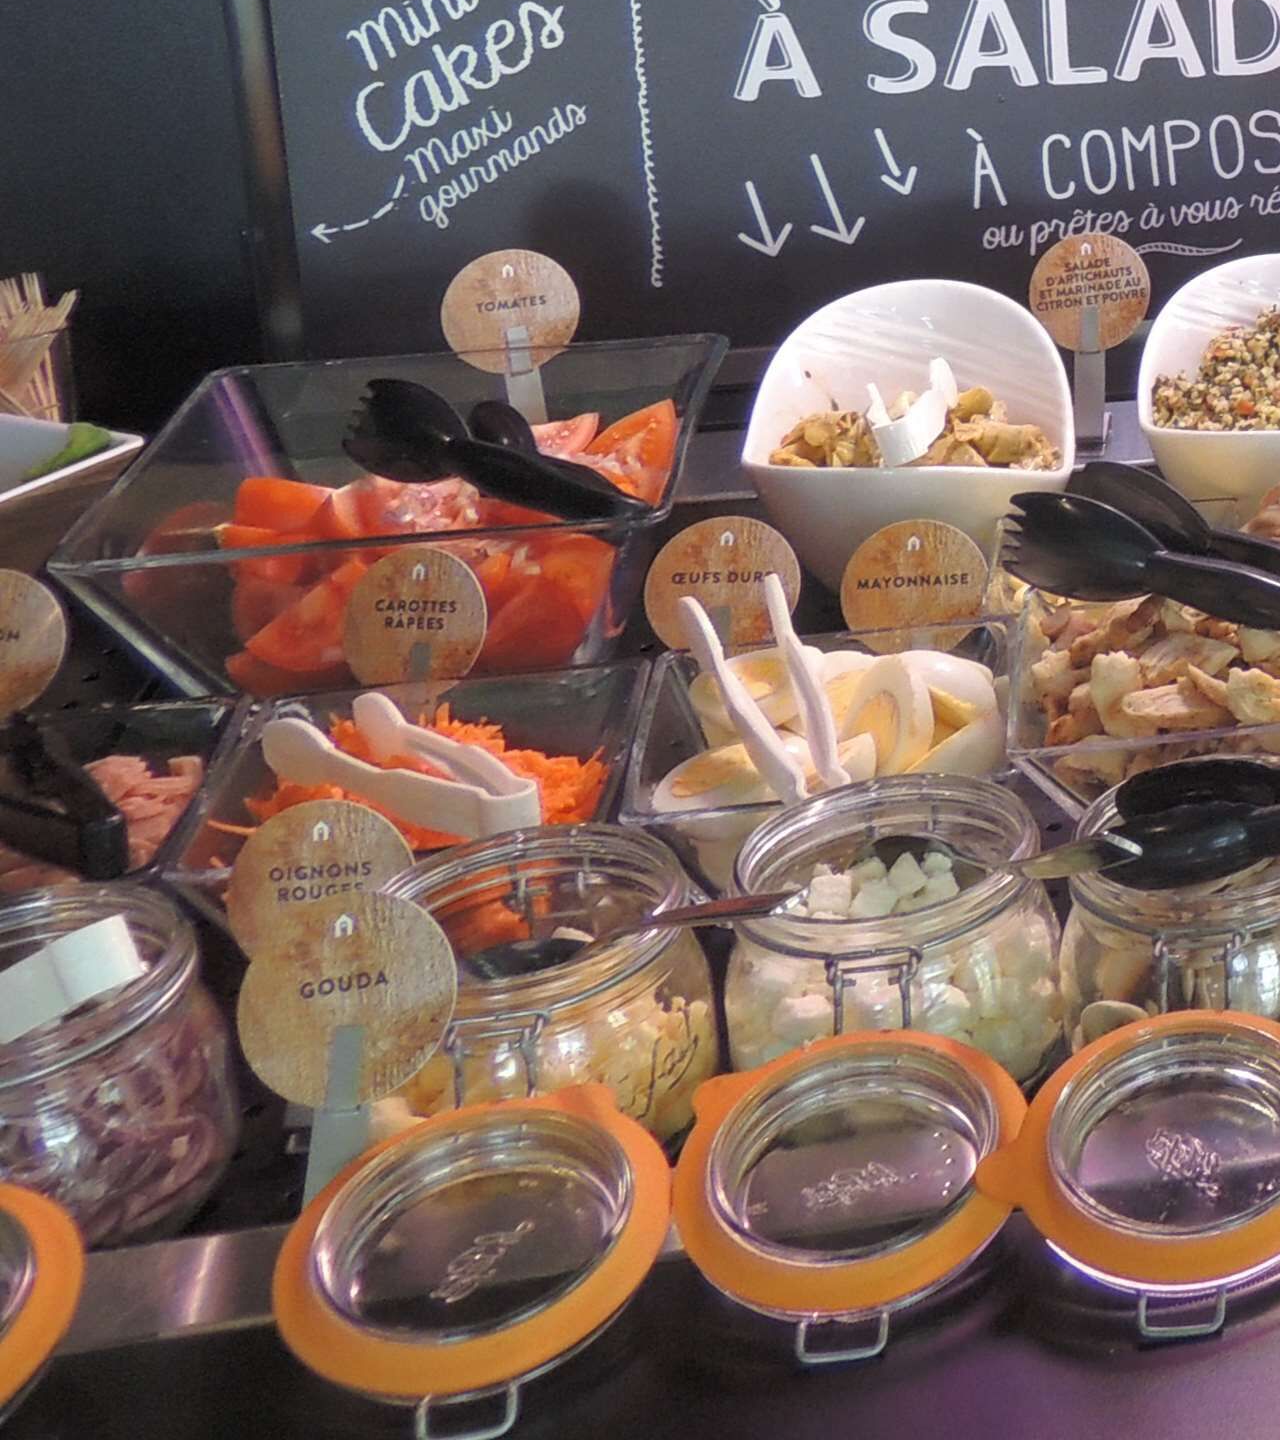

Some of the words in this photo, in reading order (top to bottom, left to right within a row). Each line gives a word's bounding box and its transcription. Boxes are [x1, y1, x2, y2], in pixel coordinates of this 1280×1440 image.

[419, 103, 587, 229] gourmands
[966, 128, 1008, 210] À
[982, 220, 1025, 251] ou
[1029, 208, 1134, 257] prêtes
[1139, 202, 1167, 231] à
[1169, 194, 1244, 227] vous
[1064, 257, 1112, 273] SALADE
[1045, 266, 1133, 287] D'ARTICHAUTS
[1039, 289, 1052, 300] ET
[1056, 280, 1121, 297] MARINADE
[1124, 276, 1141, 288] AU
[475, 294, 547, 313] TOMATES
[1036, 297, 1083, 312] CITRON
[1086, 293, 1099, 305] ET
[1102, 287, 1147, 304] POIVRE
[856, 572, 970, 591] MAYONNAISE
[374, 598, 457, 614] CAROTTES
[269, 861, 372, 881] OIGNONS
[300, 969, 389, 1000] GOUDA
